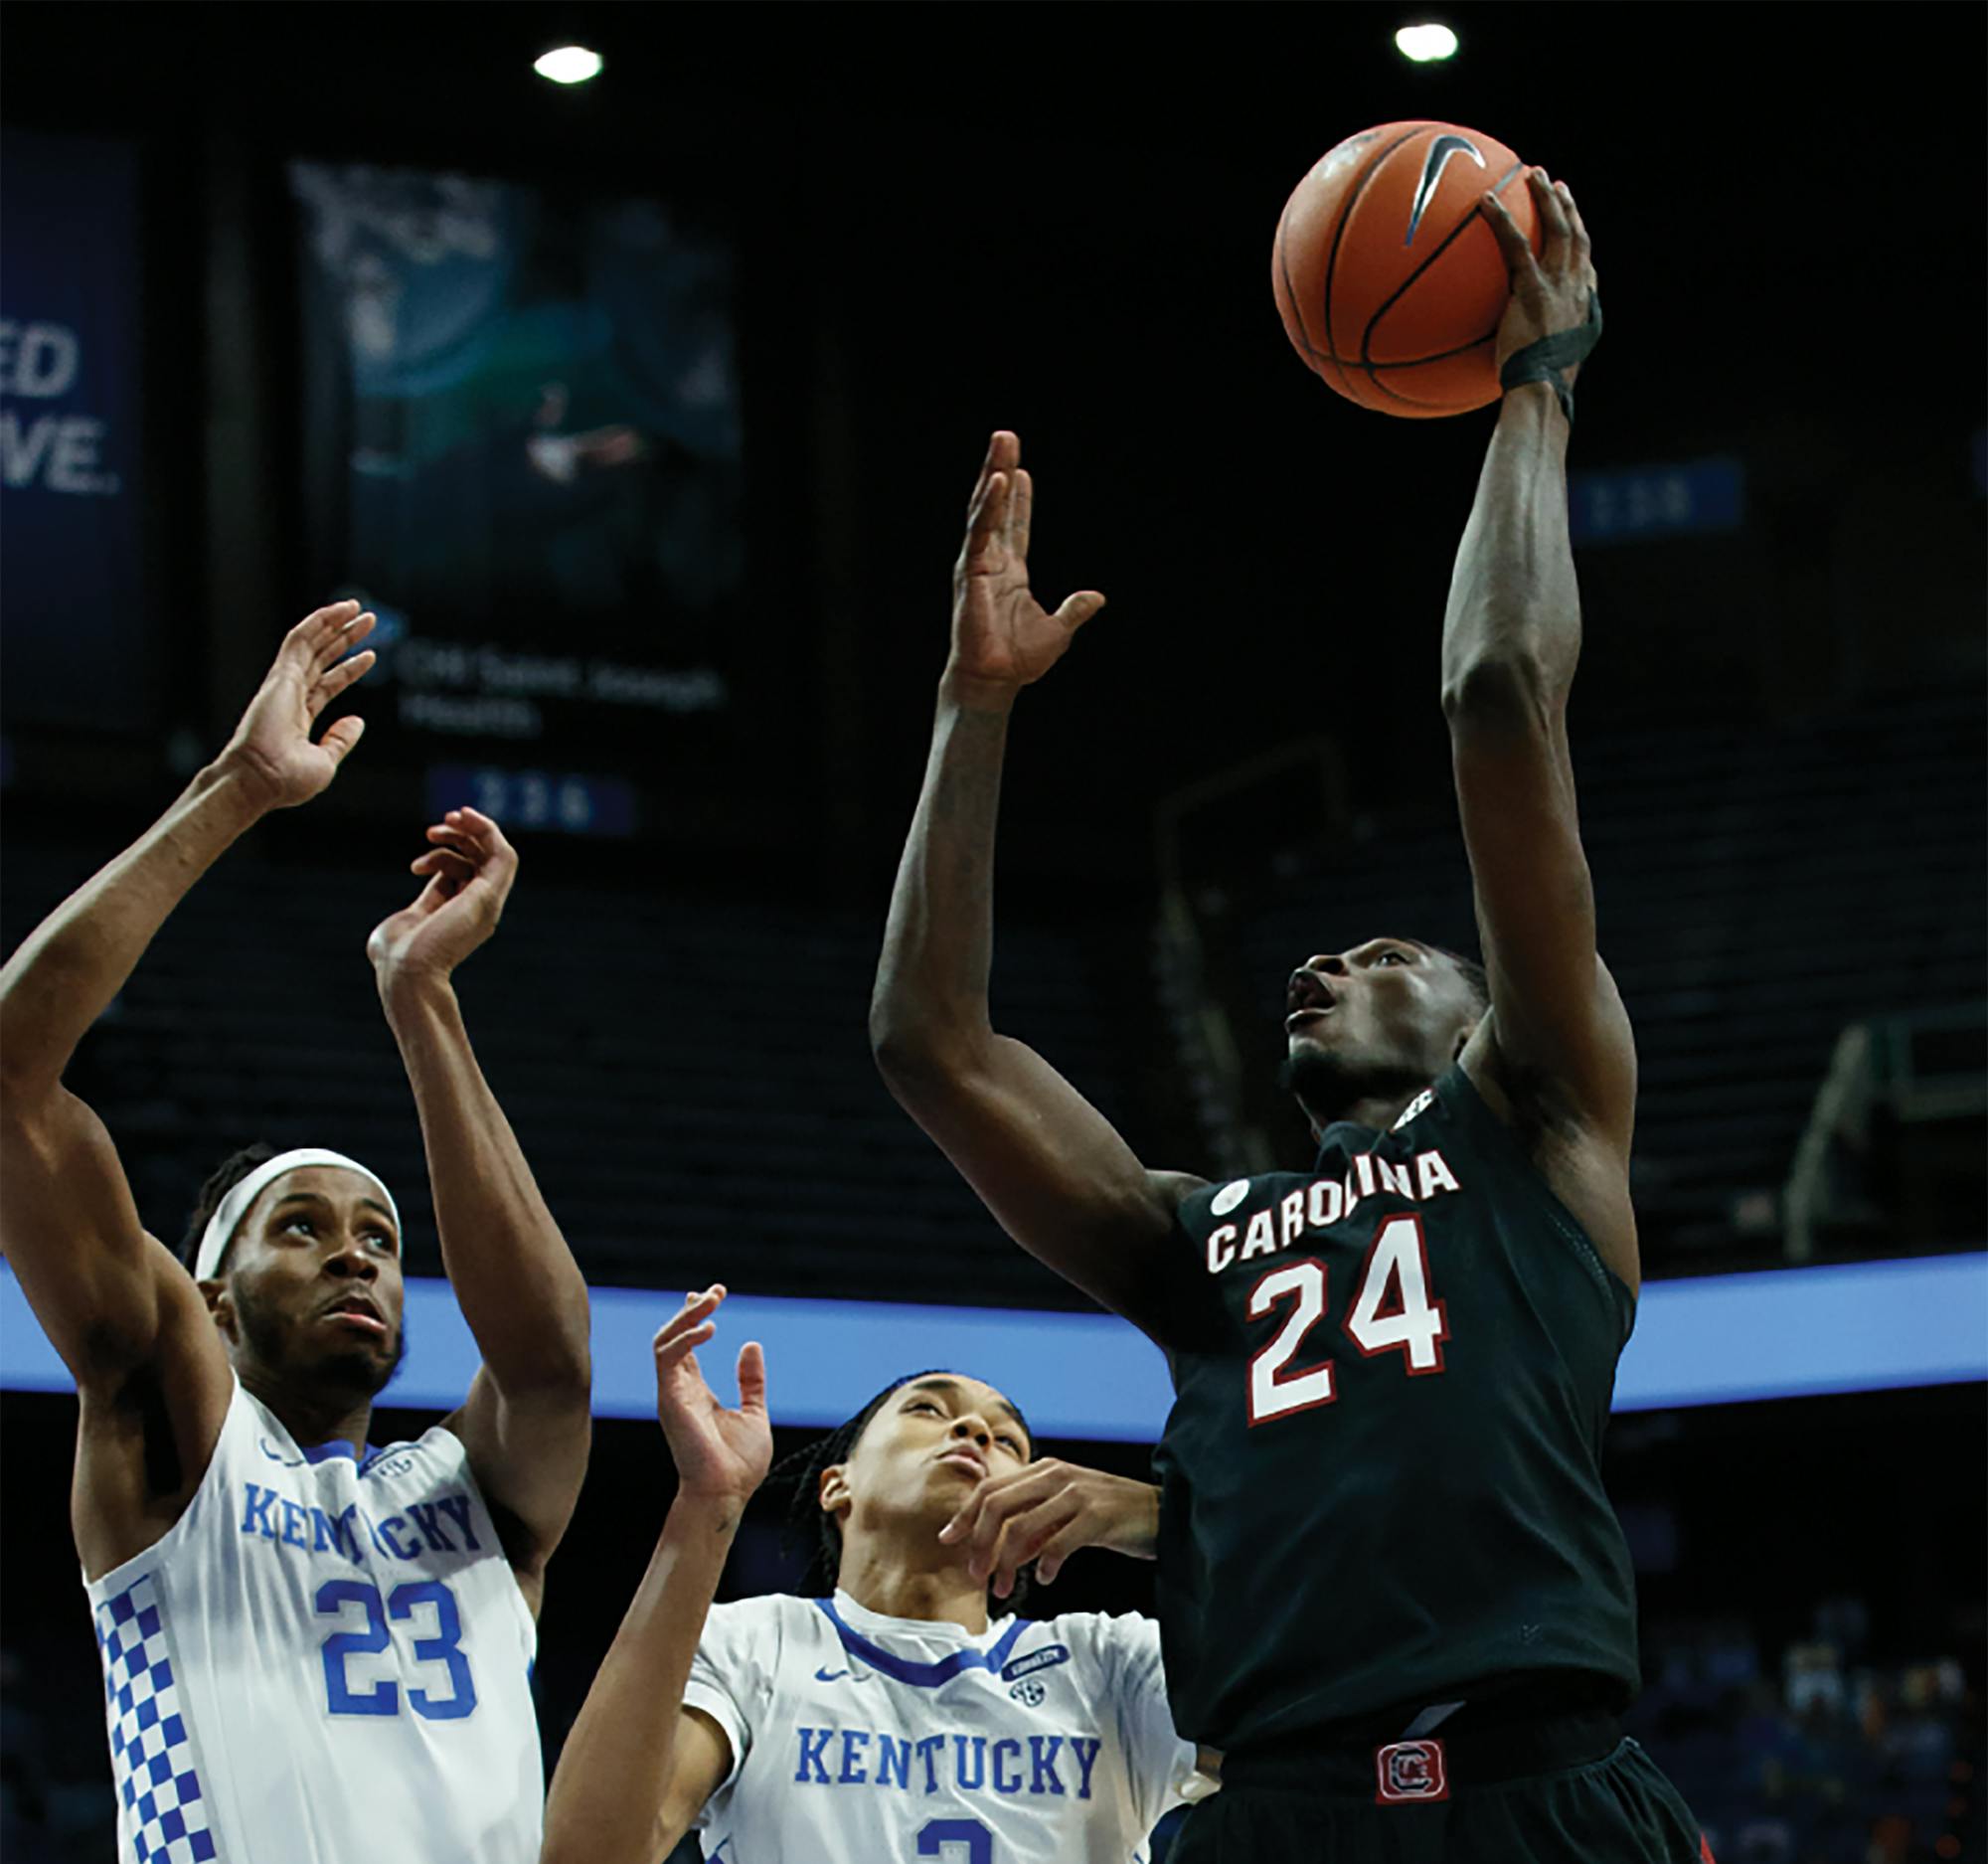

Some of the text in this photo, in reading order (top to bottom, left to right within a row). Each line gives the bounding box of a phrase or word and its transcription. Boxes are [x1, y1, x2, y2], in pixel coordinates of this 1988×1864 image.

[1205, 1148, 1462, 1274] CAROLINA
[1245, 1211, 1450, 1429] 24
[241, 1481, 481, 1566] KENTCKY
[314, 1578, 478, 1721] 23
[794, 1727, 1102, 1799] KENTUCKY
